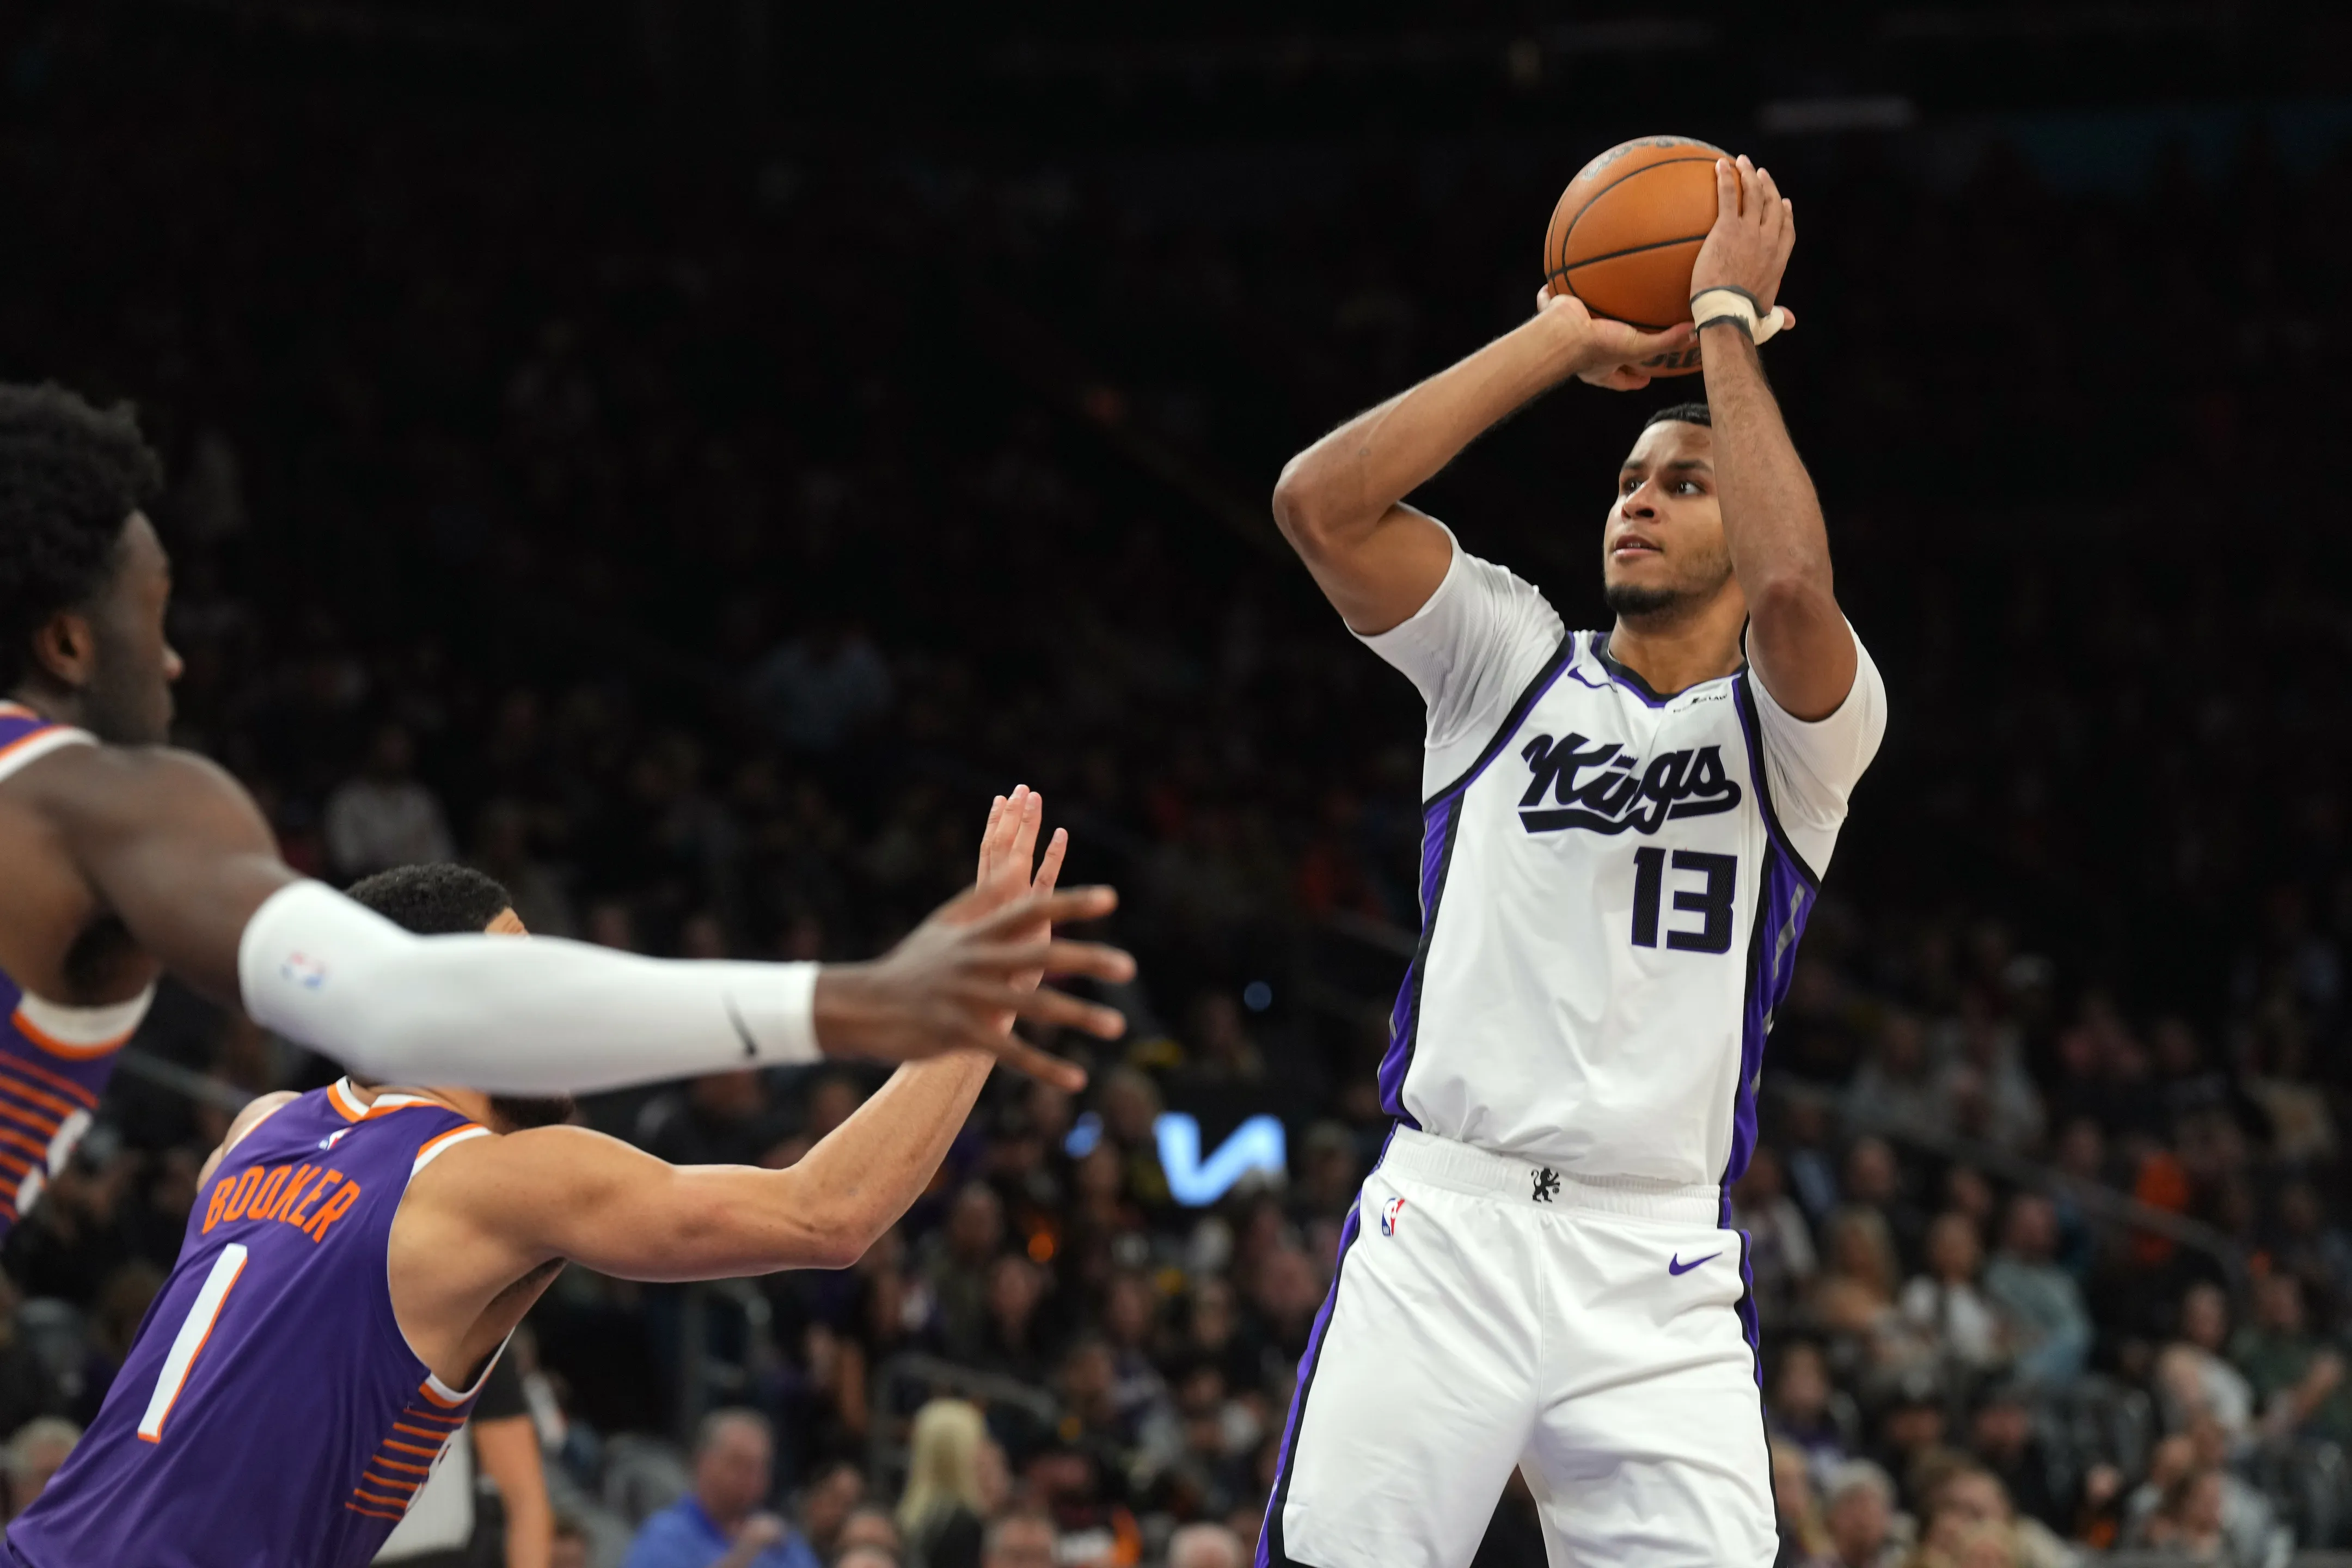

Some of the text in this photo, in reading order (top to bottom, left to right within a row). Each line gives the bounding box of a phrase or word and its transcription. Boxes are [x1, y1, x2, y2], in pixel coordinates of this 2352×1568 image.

[1631, 846, 1737, 954] 13
[201, 1164, 361, 1244] BOOKER
[137, 1242, 248, 1444] 1
